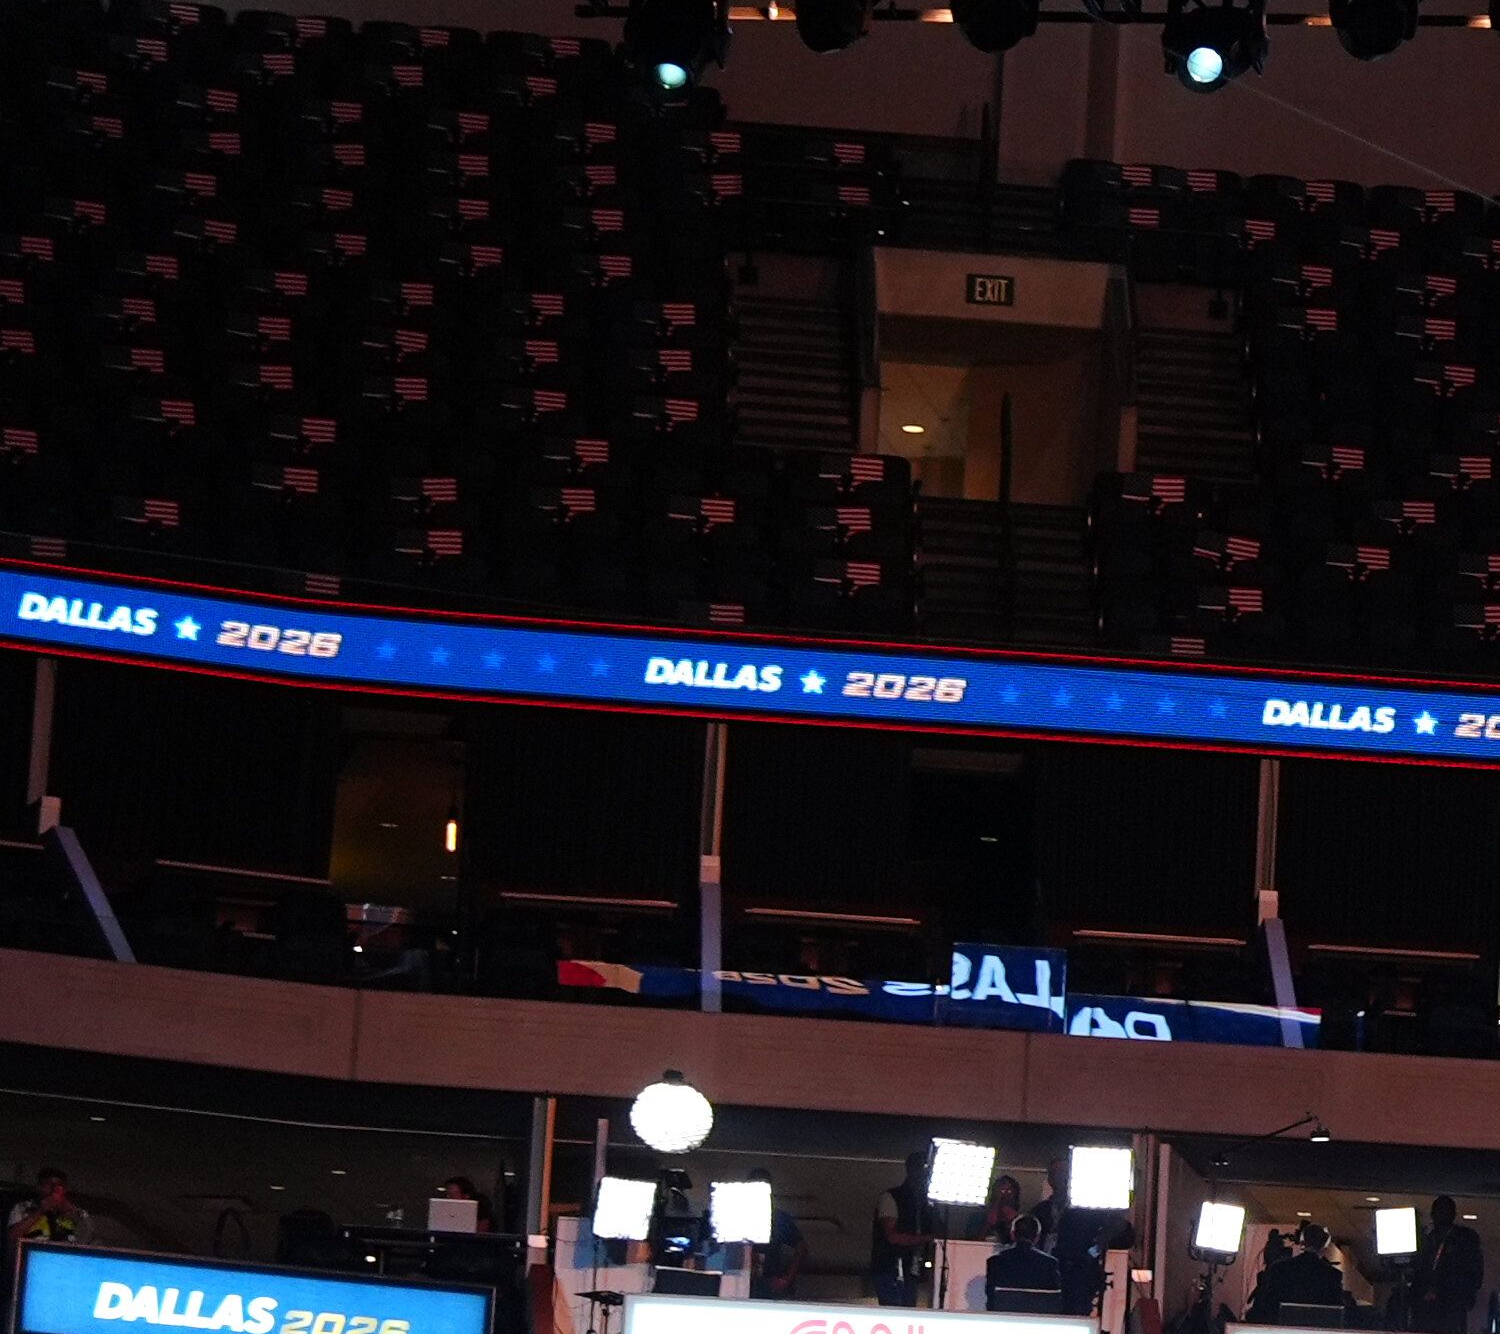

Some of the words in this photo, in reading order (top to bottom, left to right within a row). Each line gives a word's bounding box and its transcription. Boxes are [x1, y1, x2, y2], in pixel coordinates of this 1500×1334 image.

[974, 278, 1009, 302] EXIT
[19, 594, 158, 635] DALLAS
[217, 622, 342, 657] 2026
[645, 659, 782, 692] DALLAS
[842, 673, 966, 702] 2026
[1263, 700, 1396, 733] DALLAS
[95, 1283, 276, 1334] DALLAS
